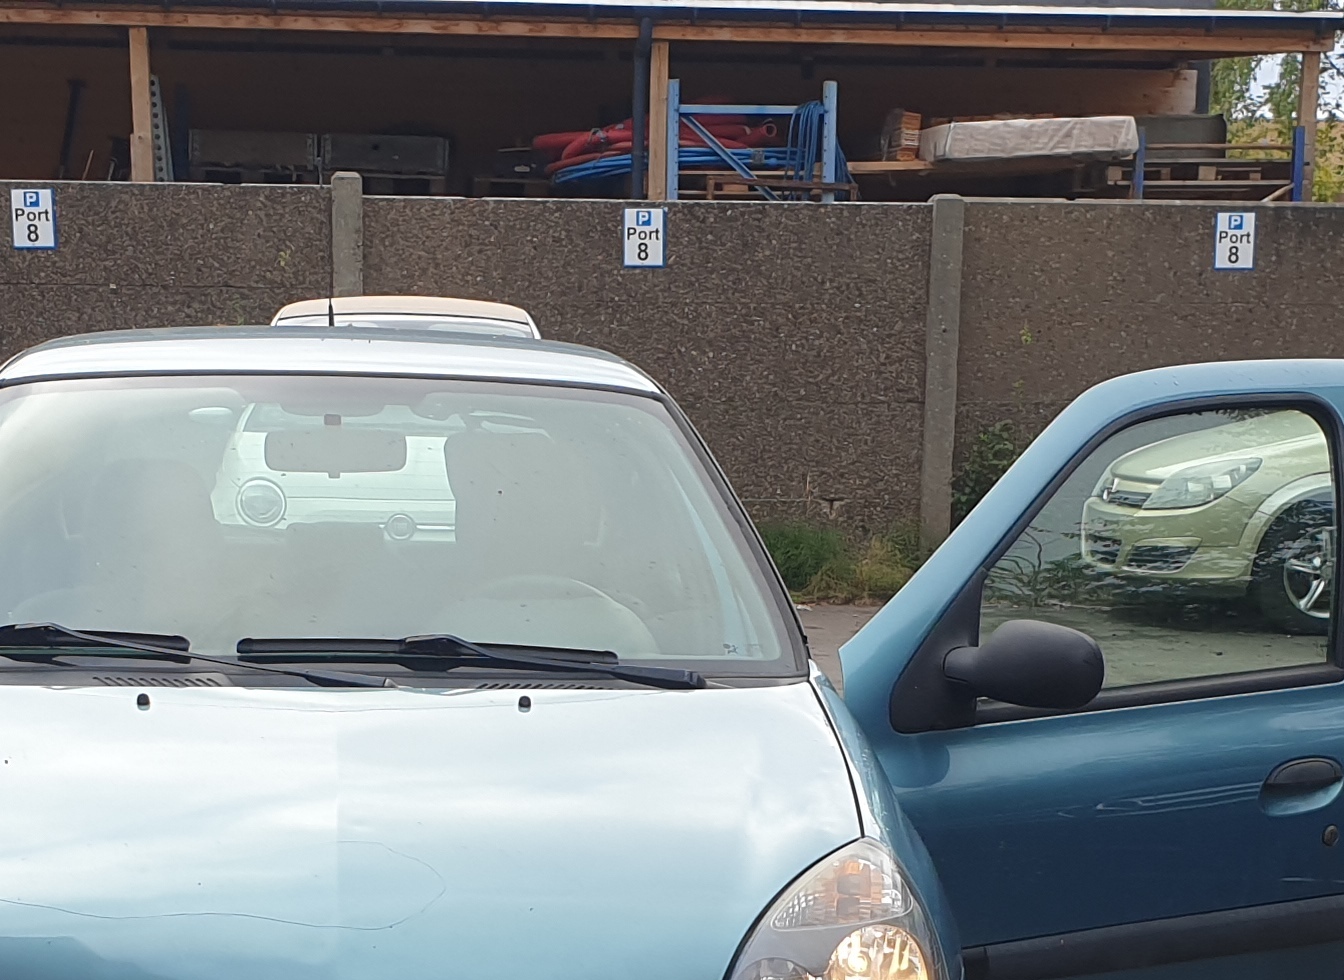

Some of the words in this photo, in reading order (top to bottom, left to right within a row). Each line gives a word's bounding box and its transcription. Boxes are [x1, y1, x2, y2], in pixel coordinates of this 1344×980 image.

[26, 192, 37, 206] P
[15, 208, 50, 222] Port
[639, 211, 650, 225] P
[1230, 215, 1242, 229] P
[27, 223, 39, 243] 8
[627, 227, 660, 241] Port
[1219, 230, 1251, 244] Port
[637, 242, 649, 261] 8
[1228, 245, 1239, 264] 8
